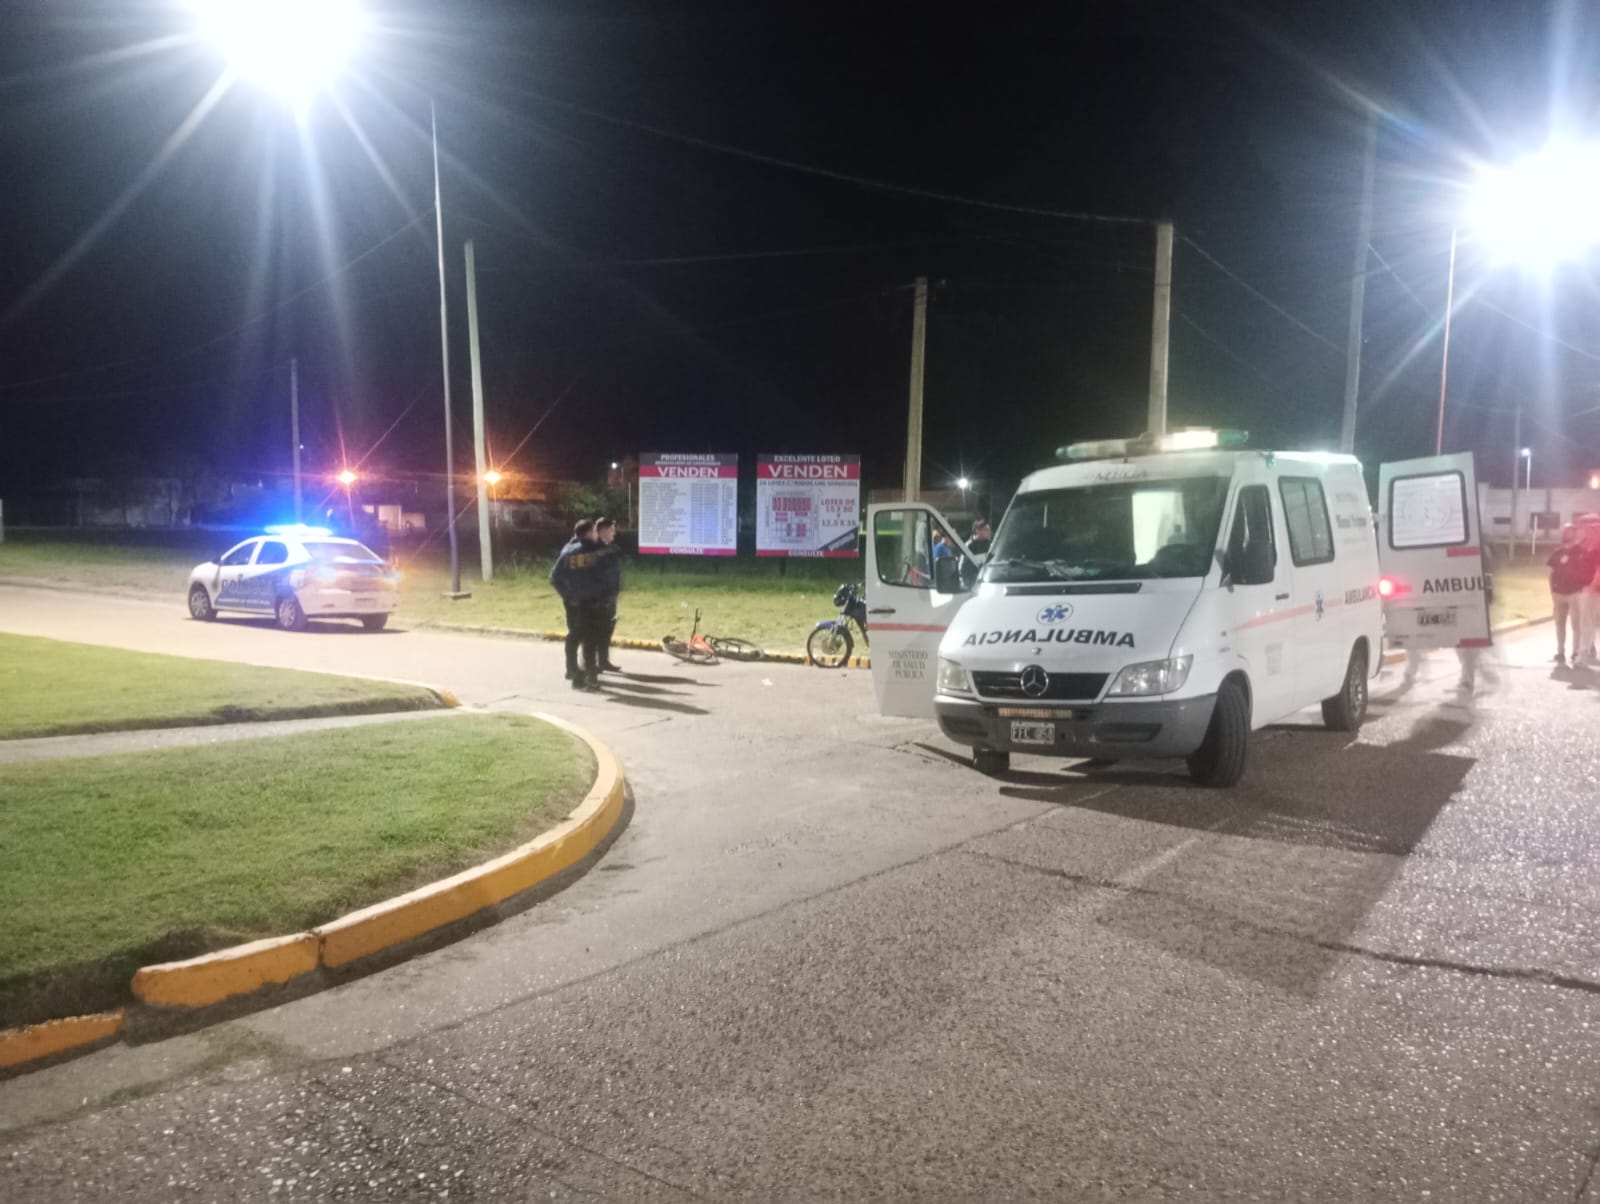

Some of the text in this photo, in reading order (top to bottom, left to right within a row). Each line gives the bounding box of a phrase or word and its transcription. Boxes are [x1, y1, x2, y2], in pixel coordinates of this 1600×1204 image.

[774, 455, 841, 463] EXCELENTE LOTEO
[657, 466, 719, 478] VENDEN
[767, 464, 848, 478] VENDEN
